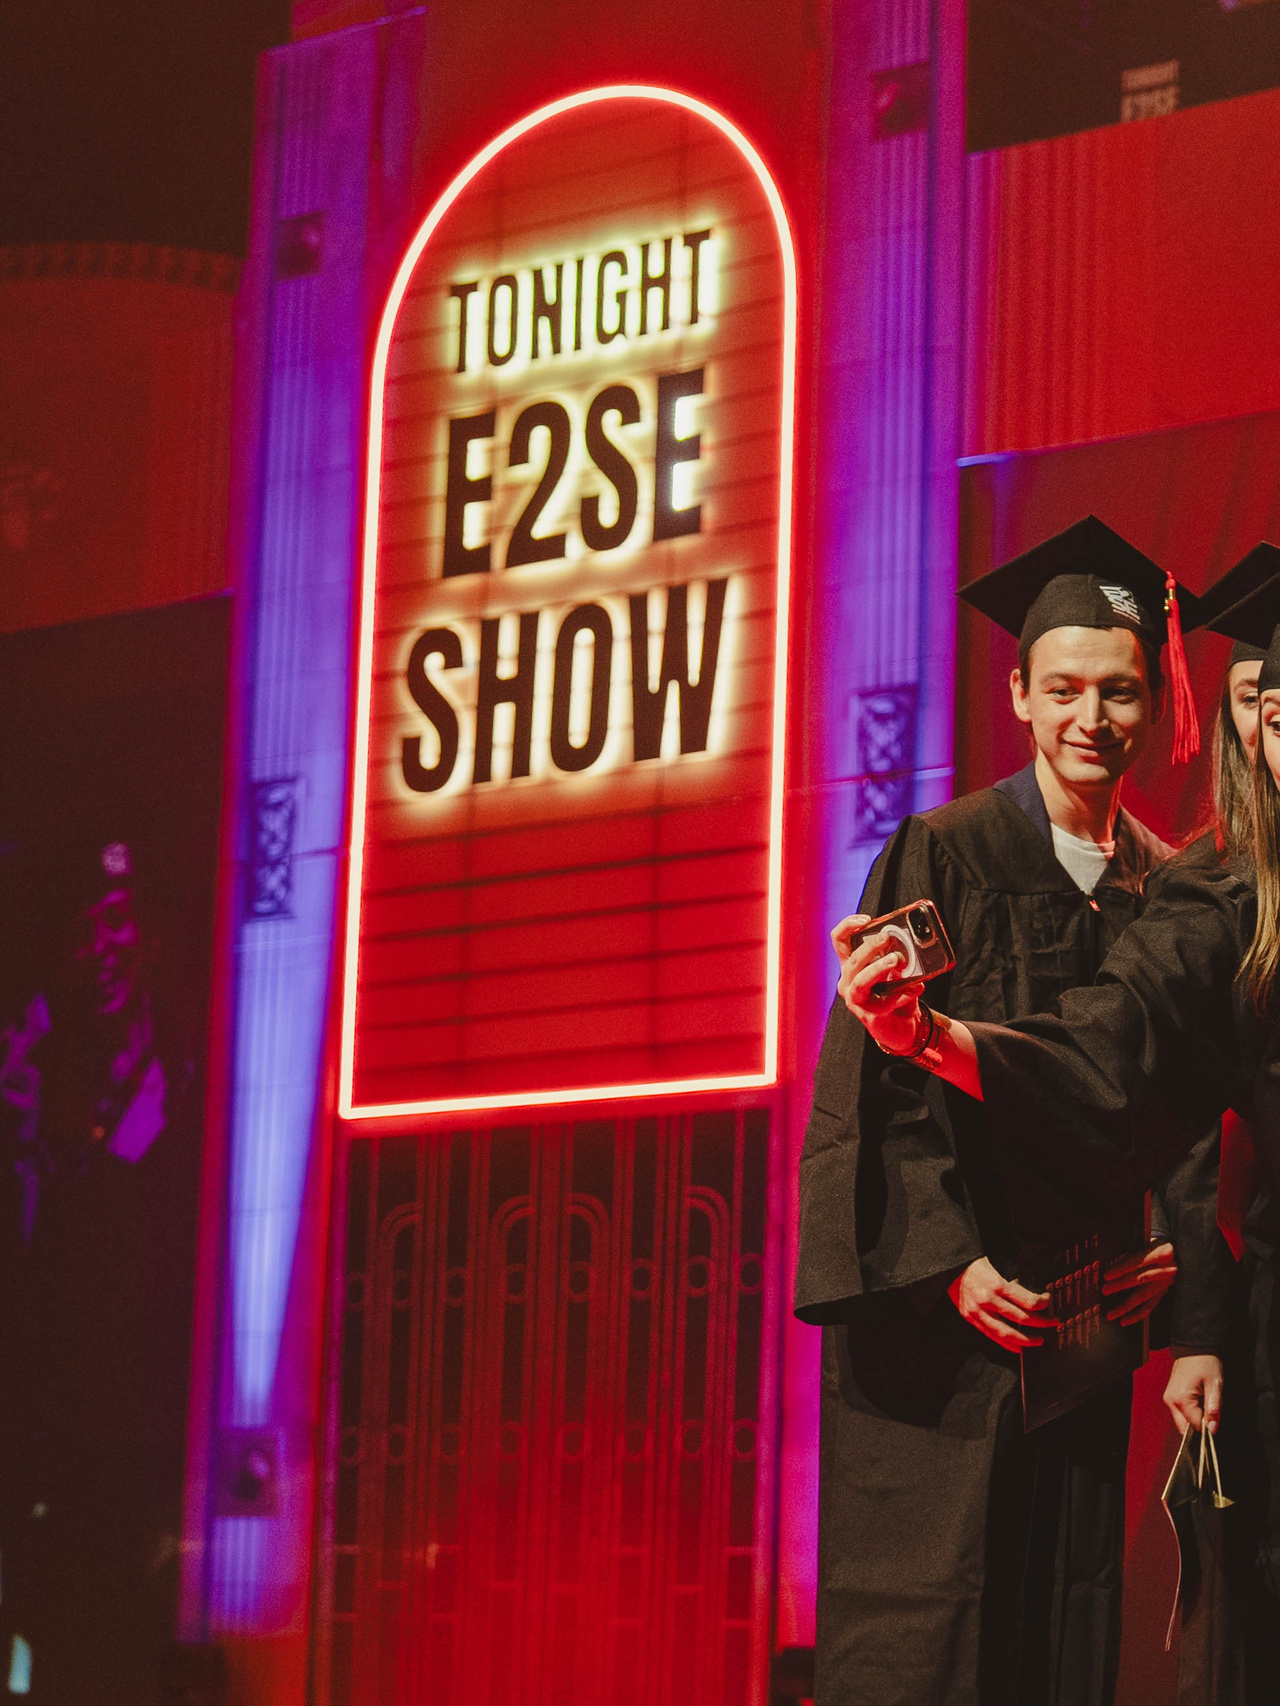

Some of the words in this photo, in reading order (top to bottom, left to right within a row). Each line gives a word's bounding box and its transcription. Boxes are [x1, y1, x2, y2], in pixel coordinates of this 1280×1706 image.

[450, 228, 711, 373] TONIGHT
[442, 368, 704, 579] E2SE
[401, 578, 729, 793] SHOW
